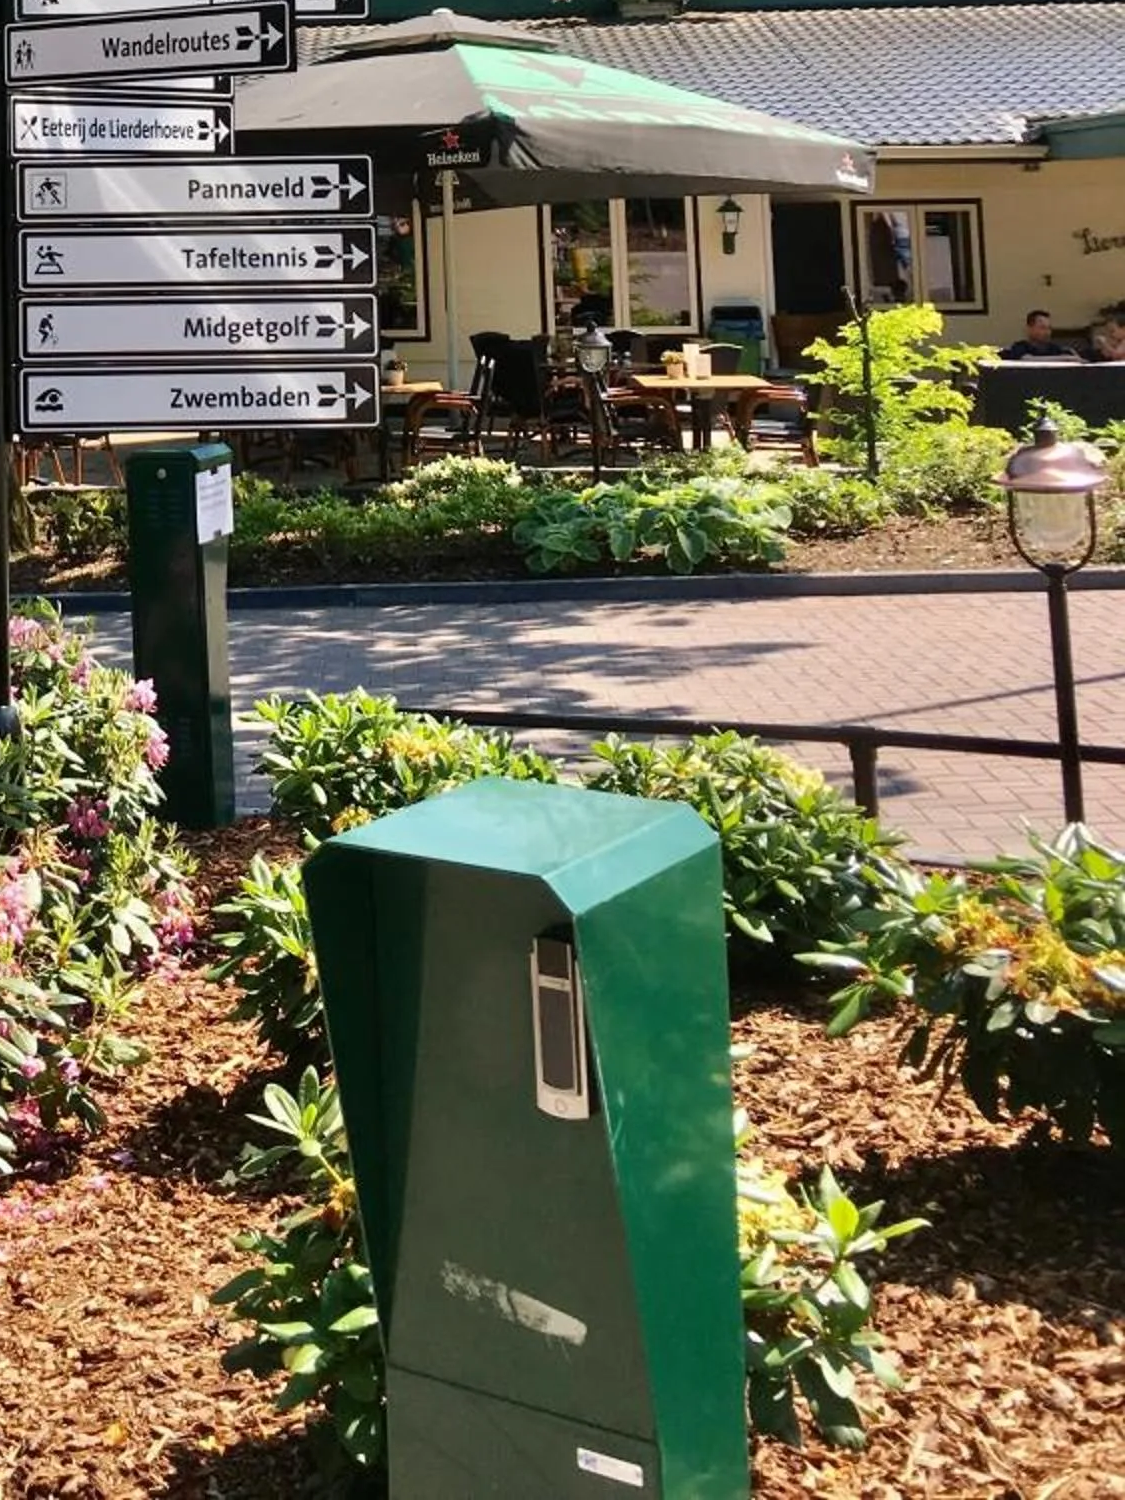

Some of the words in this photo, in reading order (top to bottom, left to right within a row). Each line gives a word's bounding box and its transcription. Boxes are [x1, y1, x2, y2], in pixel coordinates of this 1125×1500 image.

[101, 29, 231, 58] Wandelroutes
[41, 117, 86, 143] Eeterij
[89, 117, 106, 138] de
[109, 118, 194, 139] Lierderhoeve
[187, 177, 305, 199] Pannaveld
[181, 247, 308, 269] Tafeltennis
[183, 315, 310, 343] Midgetgolf
[170, 386, 310, 409] Zwembaden
